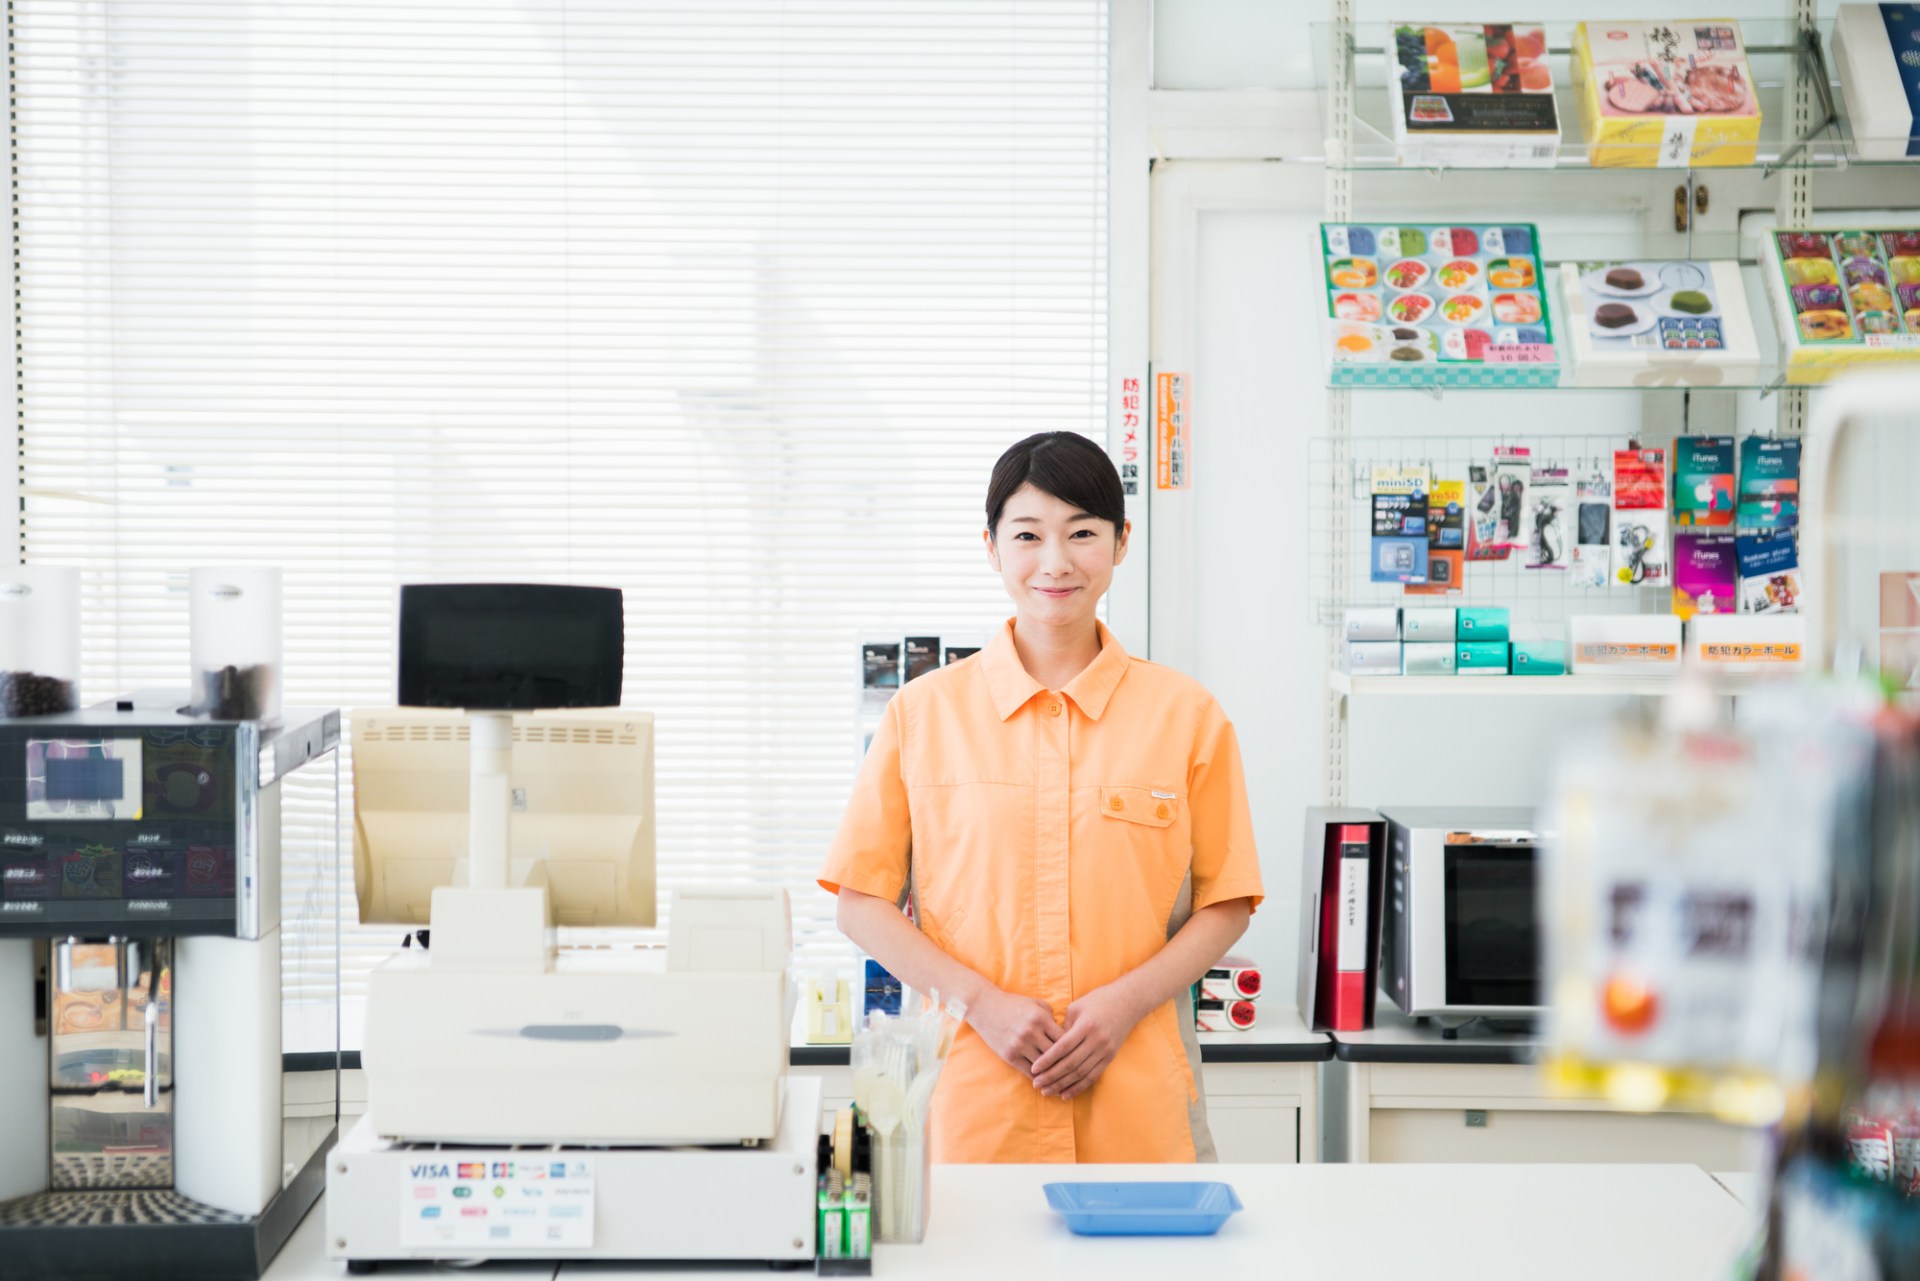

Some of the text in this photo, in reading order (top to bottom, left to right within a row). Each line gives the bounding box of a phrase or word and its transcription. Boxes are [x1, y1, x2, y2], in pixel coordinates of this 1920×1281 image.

[1377, 478, 1424, 487] miniSD
[1708, 645, 1796, 656] 防犯カラーボール
[411, 1165, 450, 1178] VISA
